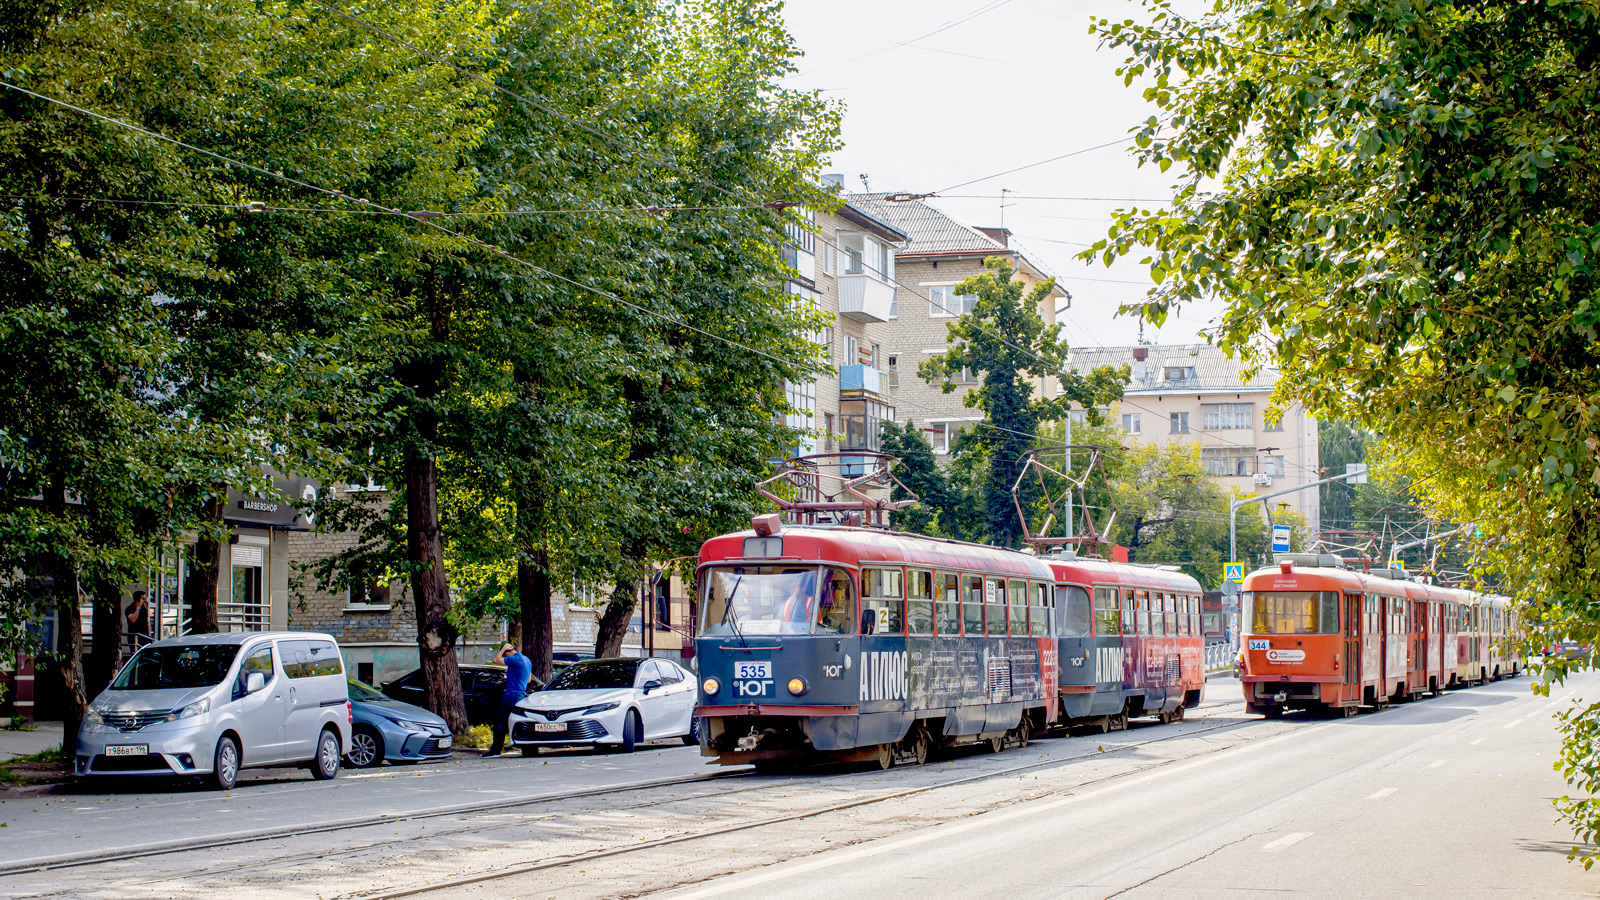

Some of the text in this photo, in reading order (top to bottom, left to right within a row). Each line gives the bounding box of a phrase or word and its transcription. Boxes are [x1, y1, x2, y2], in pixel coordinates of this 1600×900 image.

[243, 500, 277, 512] BARBERSHOP
[760, 540, 767, 552] 1
[879, 609, 888, 624] 2
[1251, 642, 1266, 650] 344
[740, 665, 766, 678] 535
